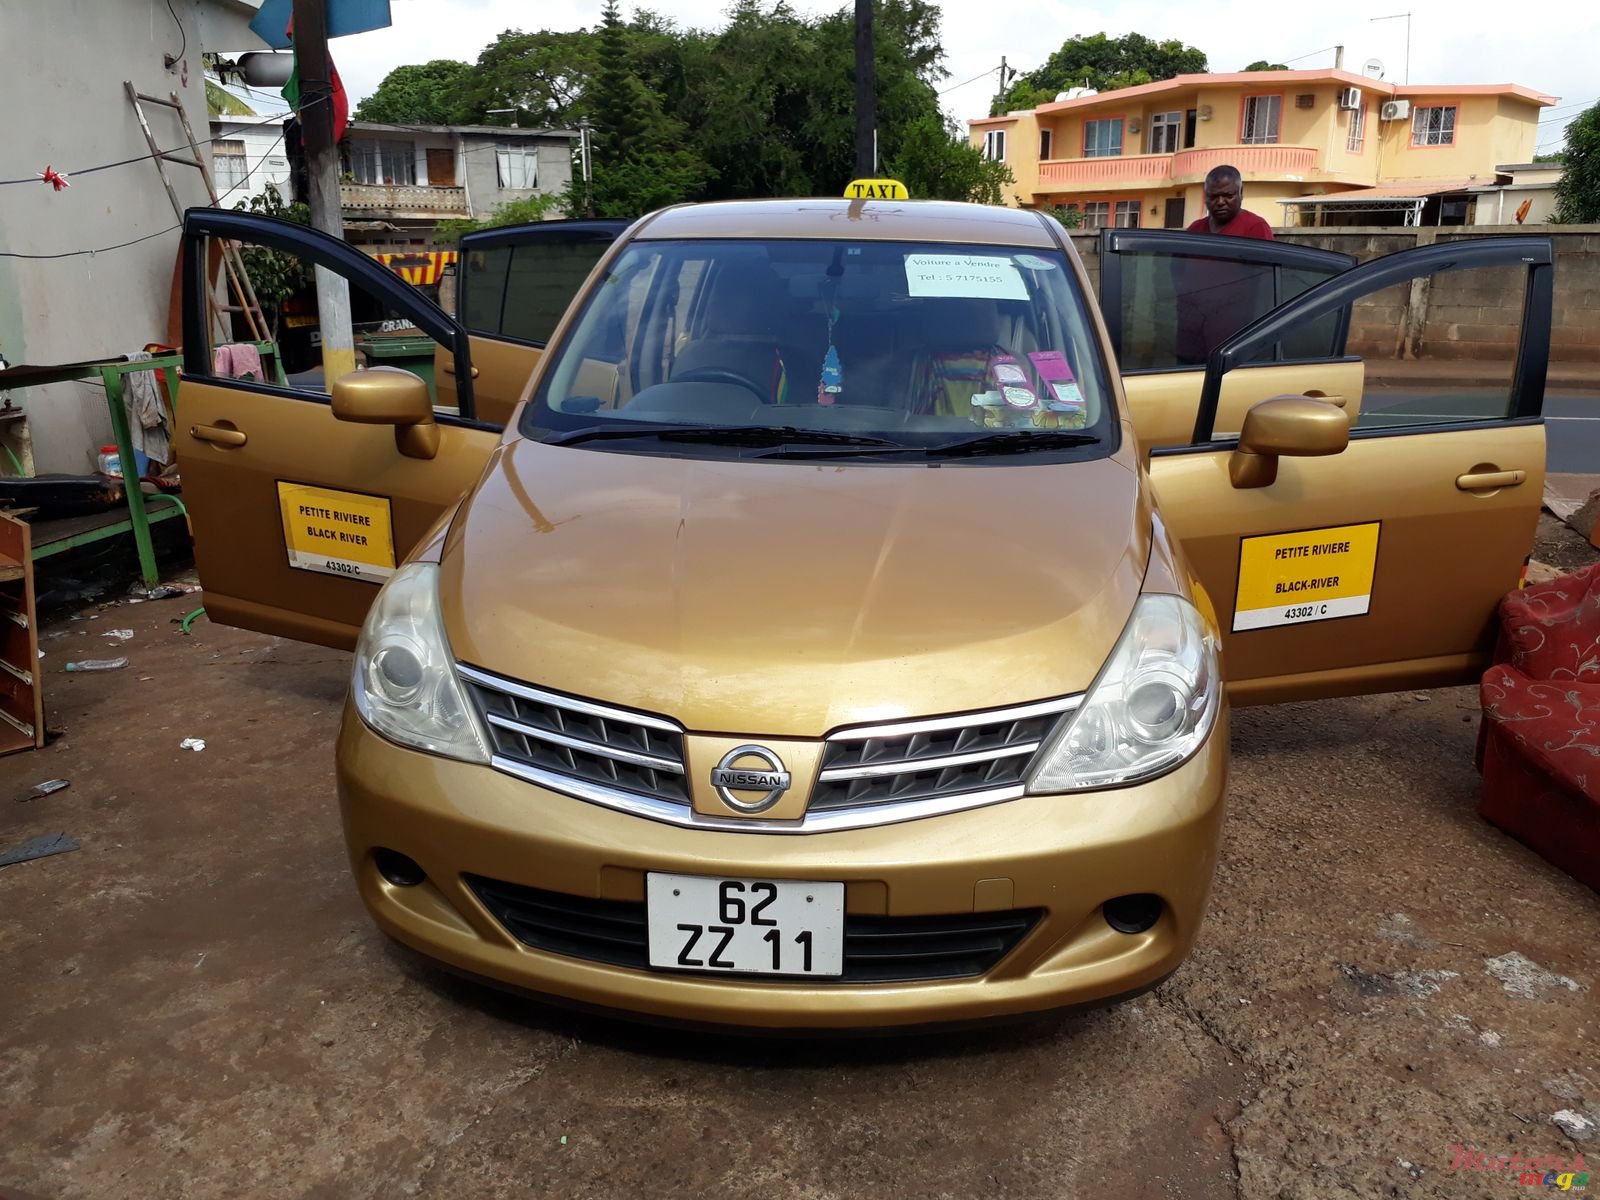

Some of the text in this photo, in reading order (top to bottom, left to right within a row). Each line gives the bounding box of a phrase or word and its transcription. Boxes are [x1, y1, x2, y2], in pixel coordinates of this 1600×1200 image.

[853, 184, 897, 199] TAXI
[964, 259, 1000, 268] Vendre
[299, 505, 371, 527] PETITE RIVIERE
[307, 526, 368, 546] BLACK RIVER
[1275, 541, 1351, 560] PETITE RIVIERE
[1275, 576, 1340, 594] BLACK-RIVER
[1284, 606, 1313, 619] 43302
[1320, 604, 1328, 615] C
[720, 773, 781, 786] NISSAN
[719, 881, 778, 926] 62
[677, 923, 813, 972] ZZ 11
